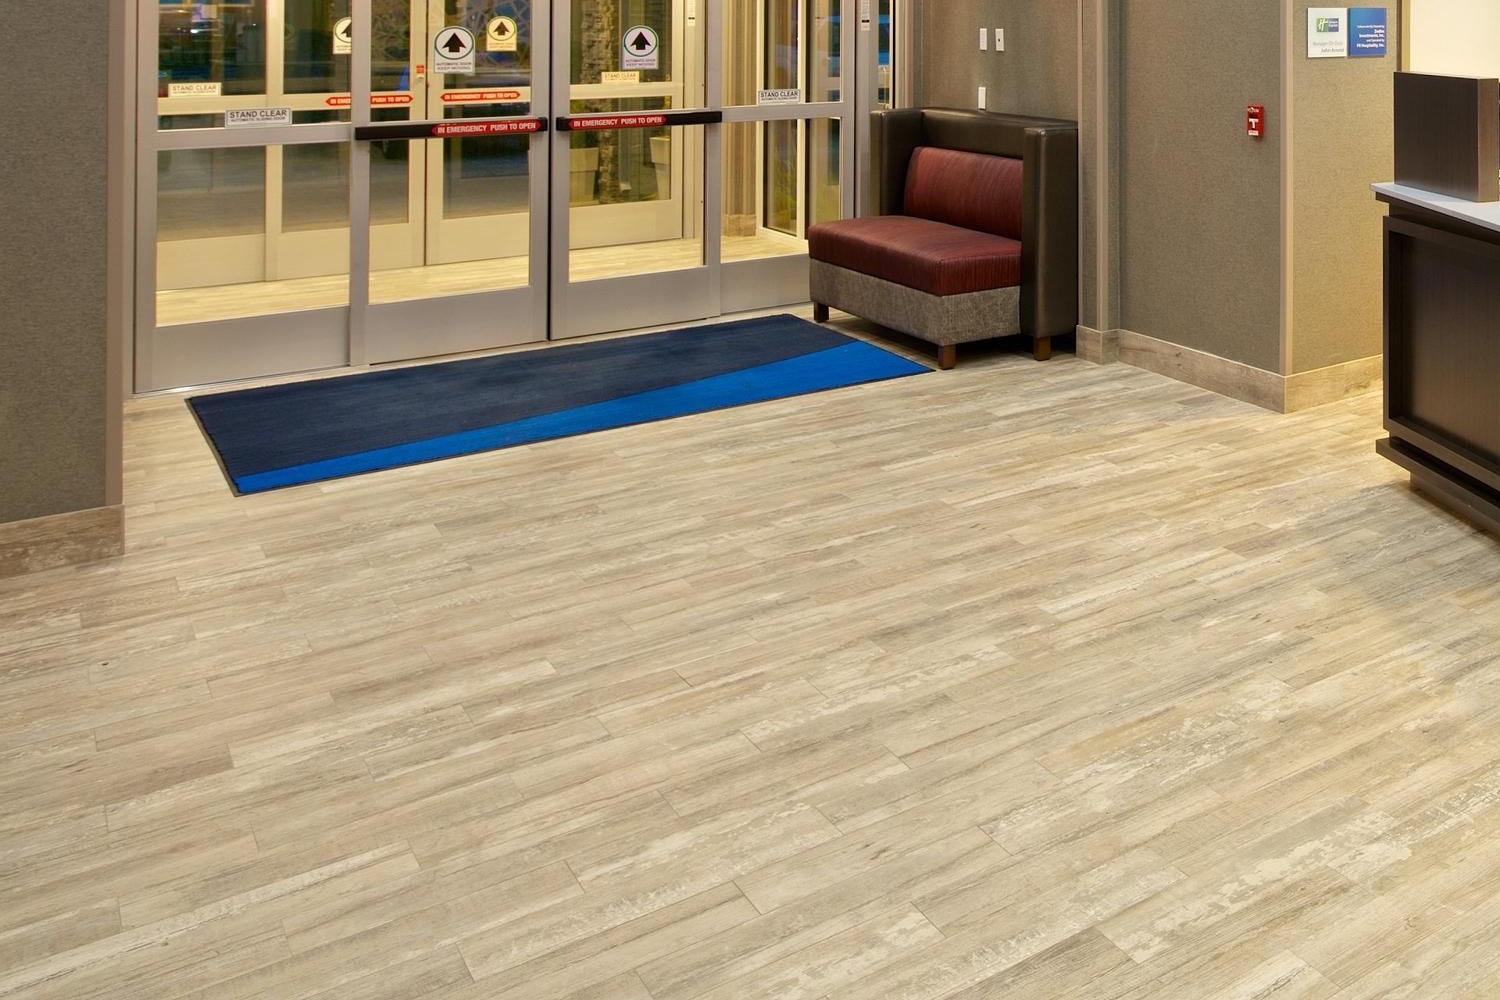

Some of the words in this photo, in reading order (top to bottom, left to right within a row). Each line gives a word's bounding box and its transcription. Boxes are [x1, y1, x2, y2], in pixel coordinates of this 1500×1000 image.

[229, 111, 258, 119] STAND
[260, 109, 287, 117] CLEAR
[446, 124, 487, 133] EMERGENCY
[490, 123, 508, 131] PUSH
[519, 122, 536, 130] OPEN
